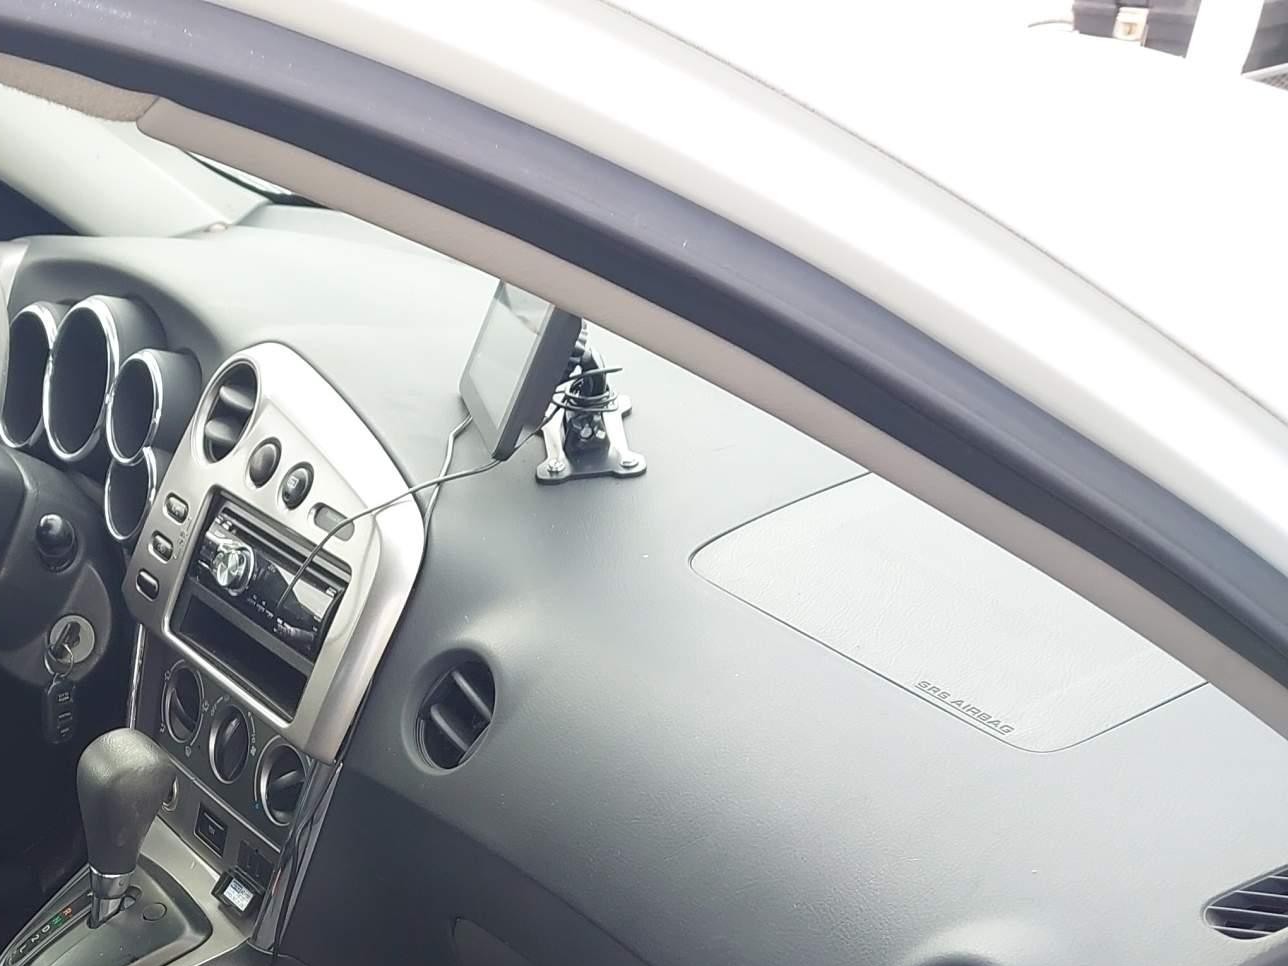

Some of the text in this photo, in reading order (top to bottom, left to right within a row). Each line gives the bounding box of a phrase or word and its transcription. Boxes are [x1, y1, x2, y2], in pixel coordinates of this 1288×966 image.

[950, 699, 1015, 734] AIRBAG
[62, 907, 72, 916] R
[41, 924, 50, 933] D
[31, 934, 40, 943] 2
